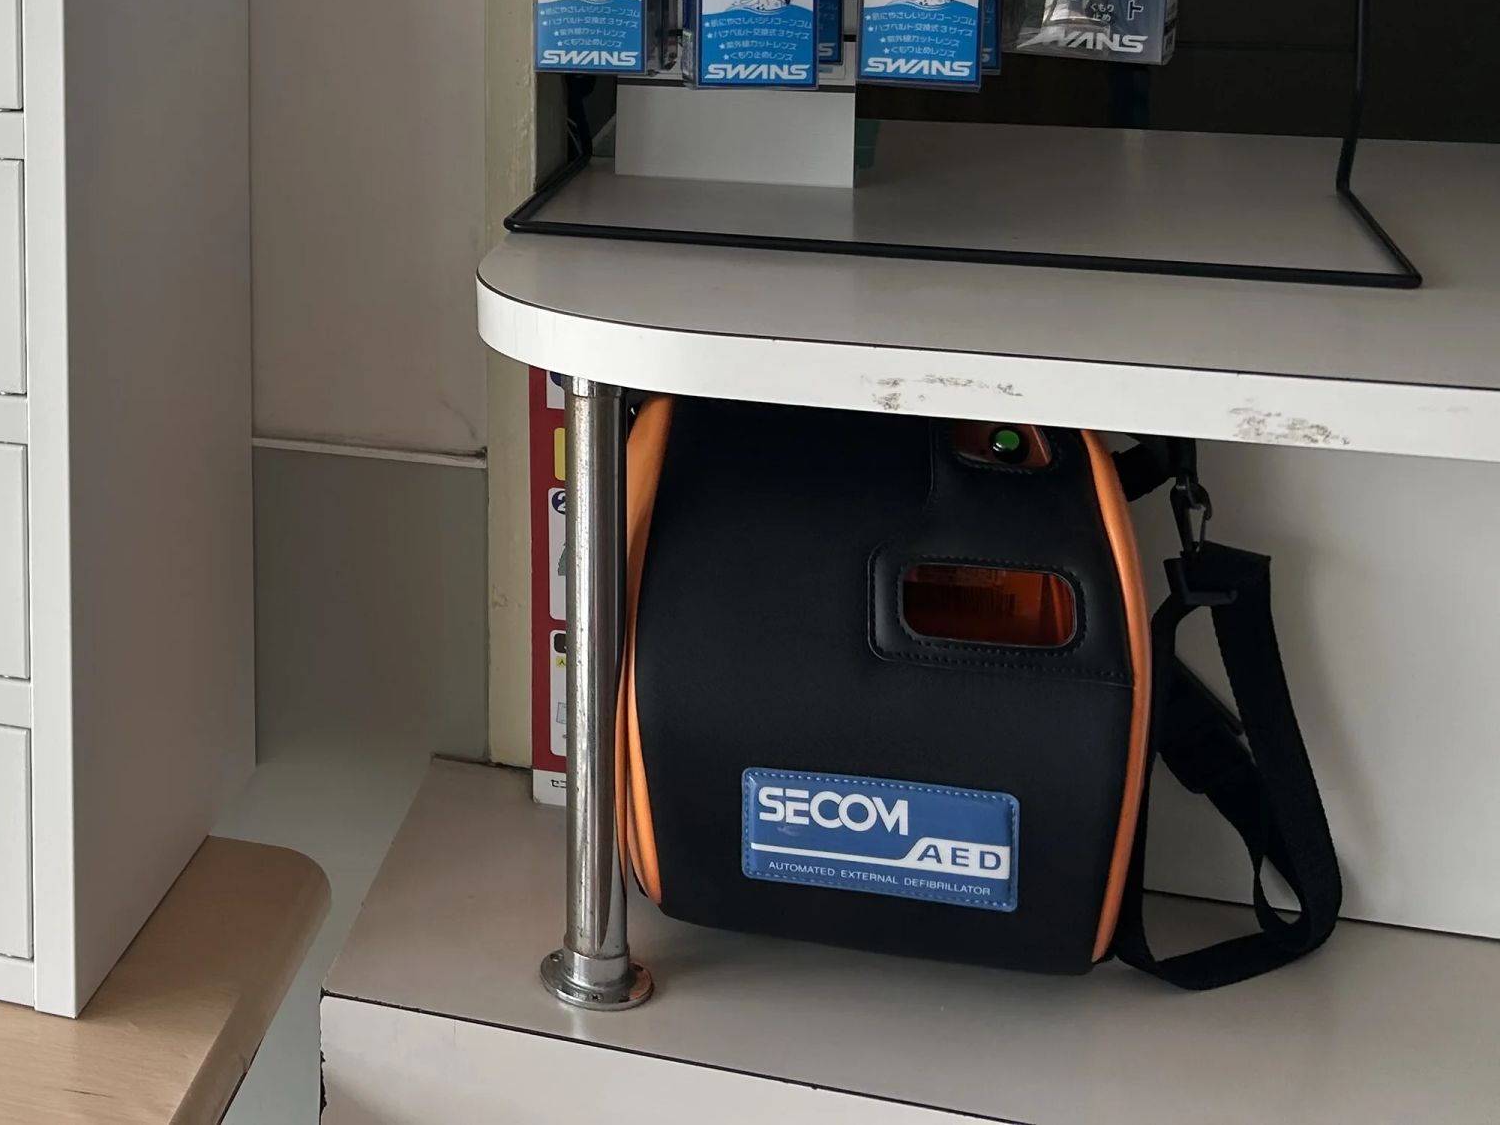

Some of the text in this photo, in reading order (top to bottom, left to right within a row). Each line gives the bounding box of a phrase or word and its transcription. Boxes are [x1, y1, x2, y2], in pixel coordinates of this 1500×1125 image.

[1090, 3, 1115, 12] くもり
[1093, 13, 1112, 21] 止め
[540, 49, 638, 66] SWANS
[704, 64, 811, 80] SWANS
[864, 57, 974, 77] SWANS
[758, 786, 908, 836] SECOM
[917, 844, 1002, 870] AED
[768, 861, 991, 896] AUTOMATED EXTERNAL DEFIBRILLATOR
